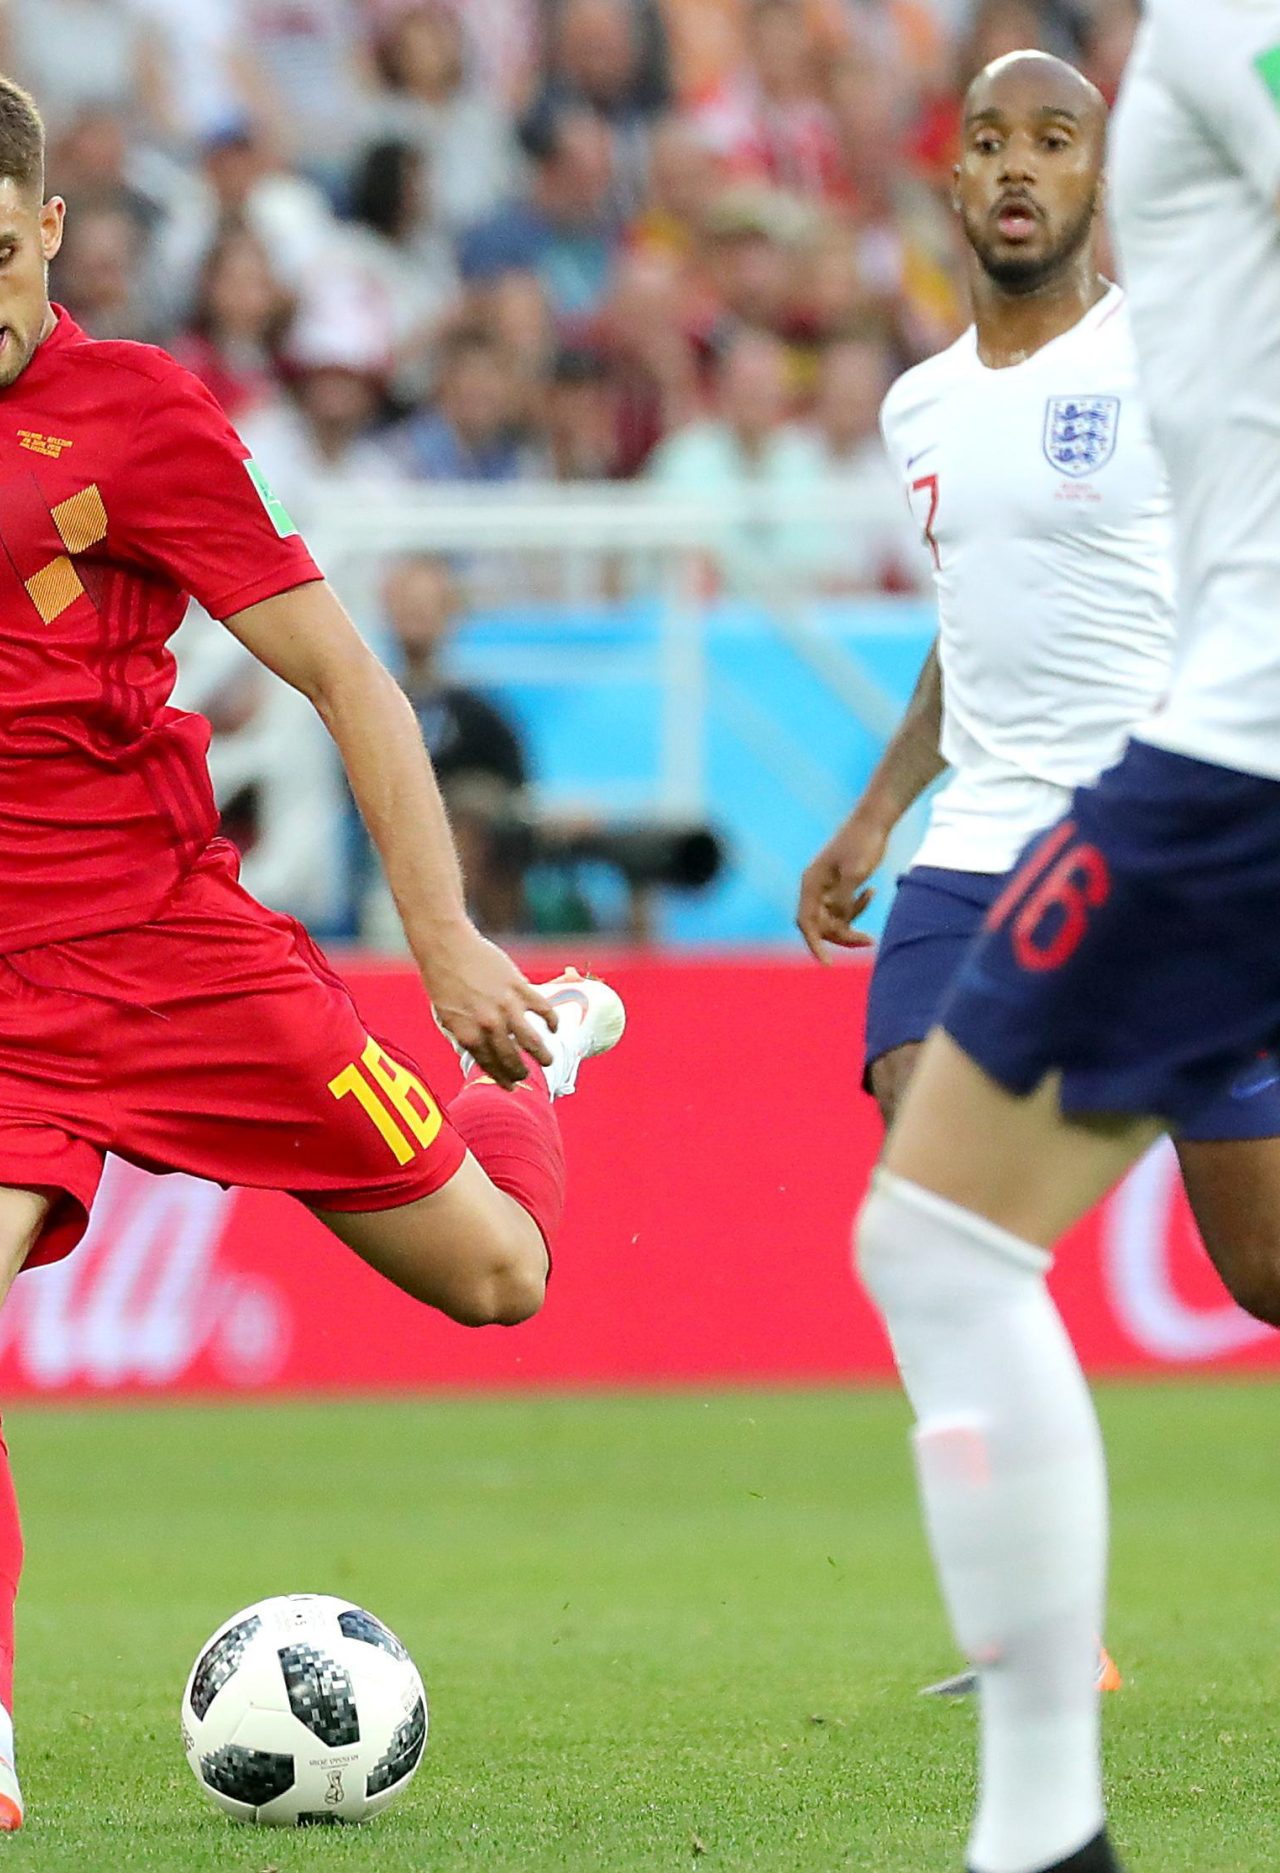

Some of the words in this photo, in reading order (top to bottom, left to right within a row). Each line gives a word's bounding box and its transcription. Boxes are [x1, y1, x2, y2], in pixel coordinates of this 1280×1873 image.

[912, 473, 942, 571] 7
[986, 822, 1111, 973] 16
[326, 1035, 444, 1167] 18
